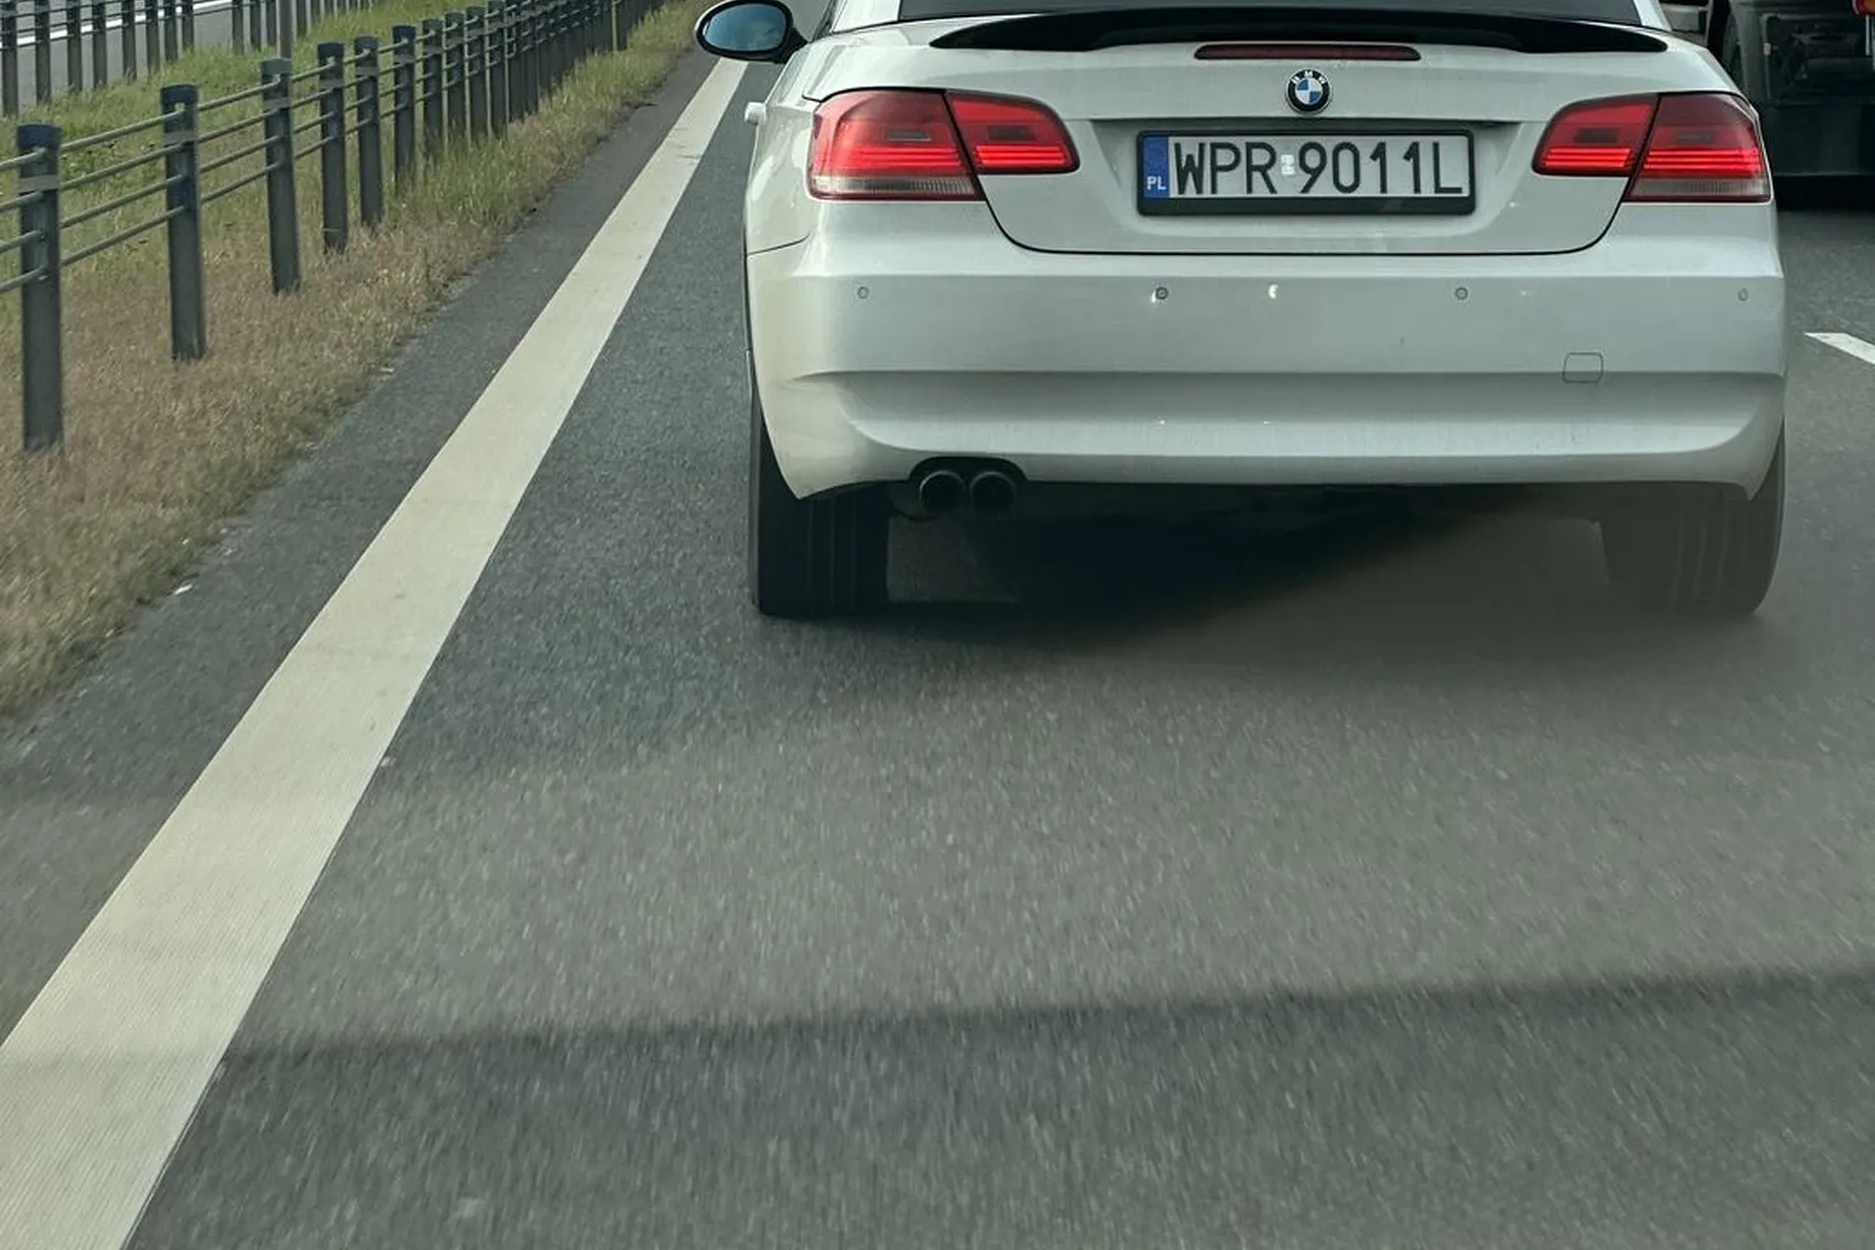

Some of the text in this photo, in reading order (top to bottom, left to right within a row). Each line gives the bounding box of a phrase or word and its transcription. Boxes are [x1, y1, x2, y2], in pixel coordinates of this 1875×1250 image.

[1291, 70, 1329, 85] BMW
[1173, 140, 1463, 196] WPR 9011L
[1146, 175, 1167, 191] PL
